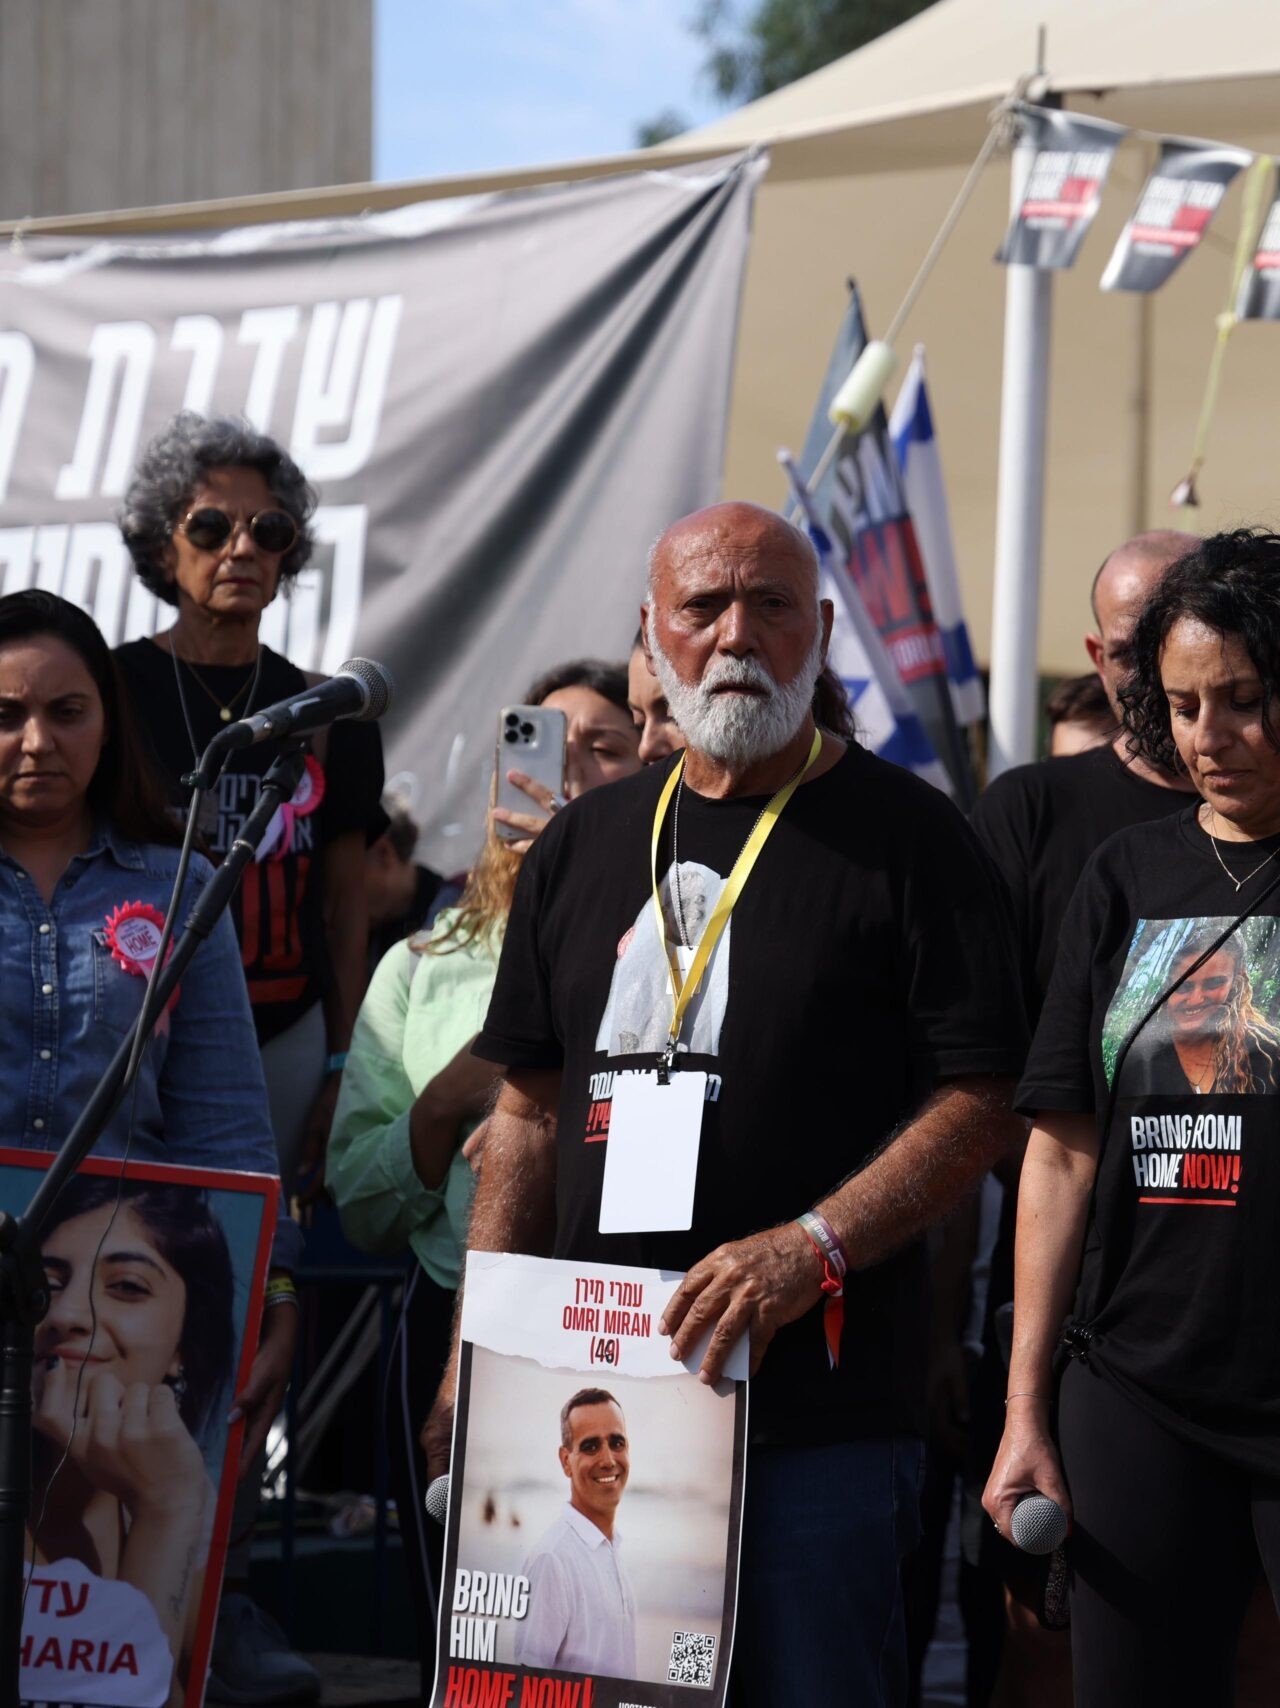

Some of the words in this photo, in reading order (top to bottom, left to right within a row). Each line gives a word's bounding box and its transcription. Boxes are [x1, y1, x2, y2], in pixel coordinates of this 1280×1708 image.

[1131, 1115, 1192, 1150] BRING
[1191, 1114, 1242, 1150] ROMI
[1132, 1153, 1183, 1188] HOME
[1182, 1153, 1241, 1194] NOW!
[575, 1278, 604, 1305] מירן
[609, 1282, 643, 1308] עמרי
[562, 1306, 600, 1331] OMRI
[603, 1312, 651, 1338] MIRAN
[453, 1568, 530, 1619] BRING
[450, 1615, 496, 1662] HIM
[444, 1666, 516, 1708] HOME
